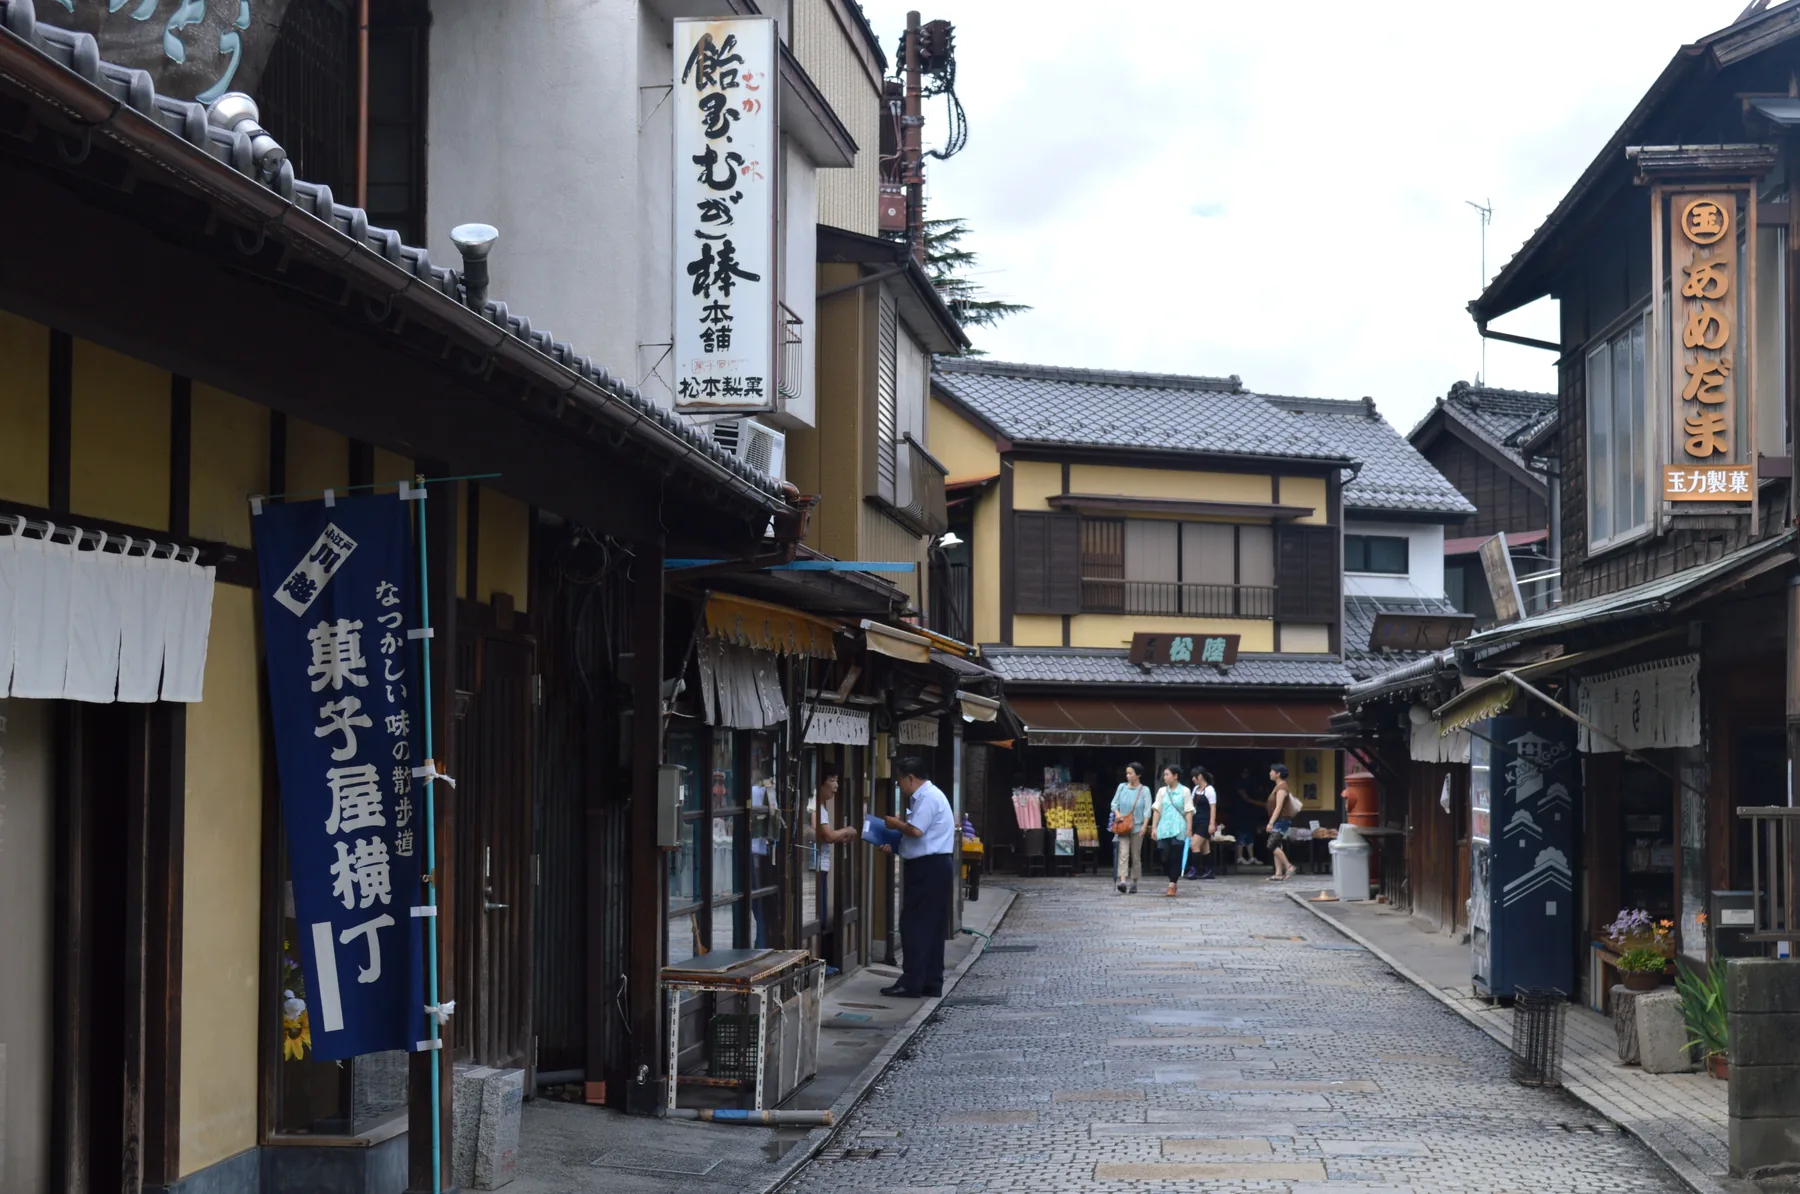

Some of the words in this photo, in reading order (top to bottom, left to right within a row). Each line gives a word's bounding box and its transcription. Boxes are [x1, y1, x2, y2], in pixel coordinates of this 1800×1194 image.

[1682, 252, 1732, 458] あめだま
[678, 376, 763, 399] 松本製菓
[1667, 470, 1749, 494] 玉力製菓
[324, 528, 354, 552] 小江戸
[283, 543, 341, 605] 川越
[375, 580, 414, 857] なつかしい味の散歩道
[307, 618, 395, 984] 菓子屋横丁
